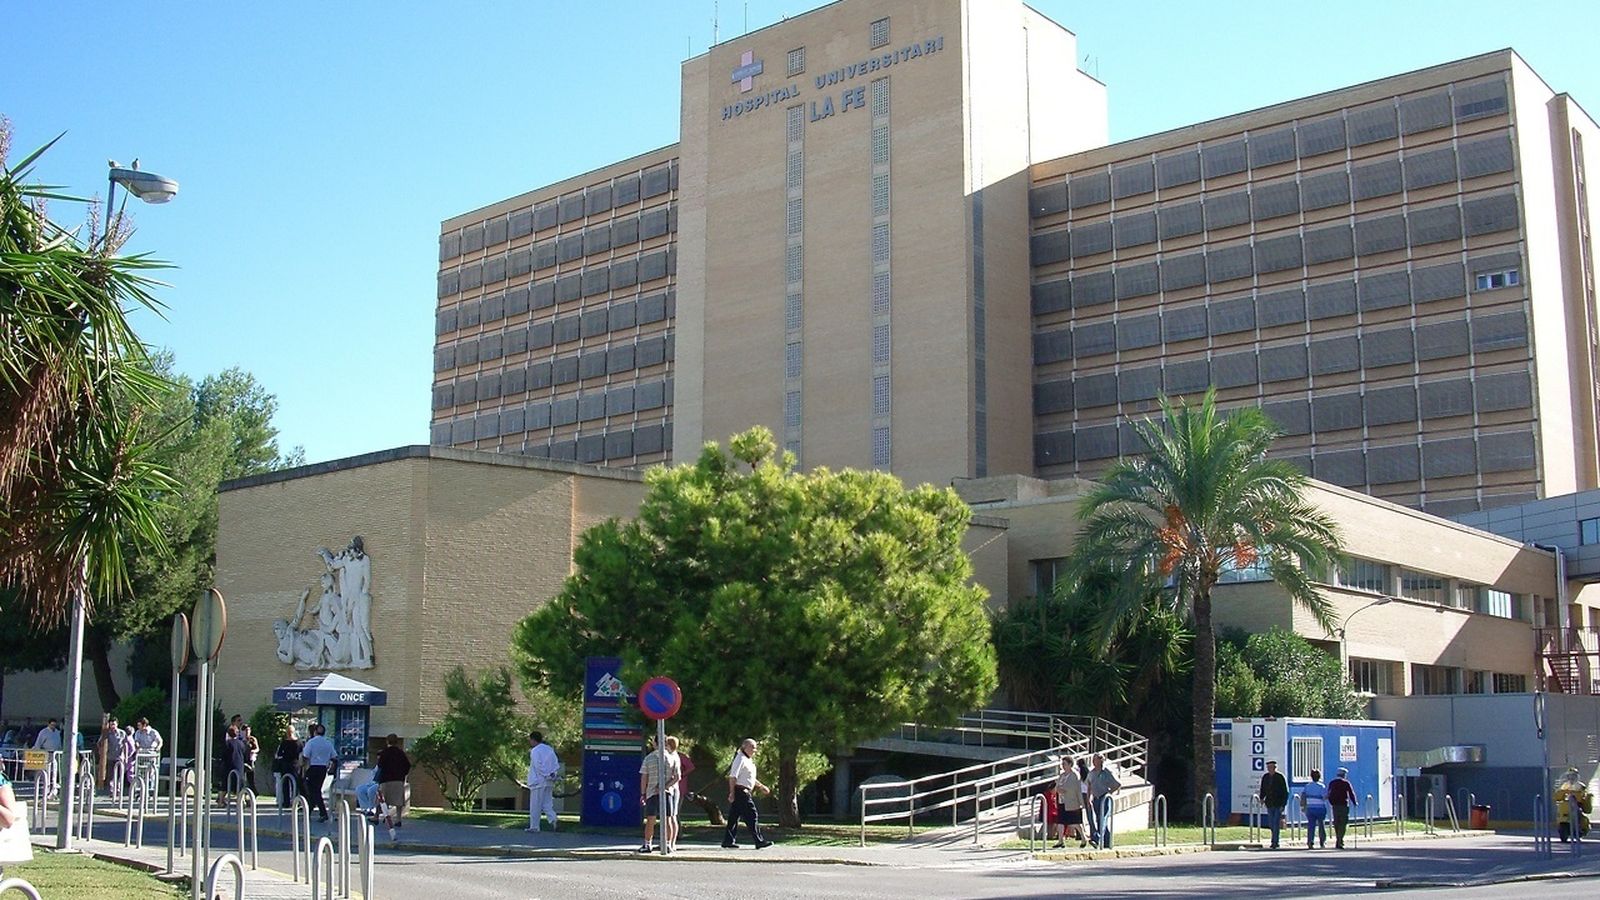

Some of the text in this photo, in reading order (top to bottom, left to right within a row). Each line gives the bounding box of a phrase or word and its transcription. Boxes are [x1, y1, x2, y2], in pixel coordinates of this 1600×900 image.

[721, 36, 944, 121] HOSPITAL UNIVERSITARI
[810, 86, 866, 123] LA FE
[286, 691, 302, 700] ONCE
[340, 692, 365, 702] ONCE
